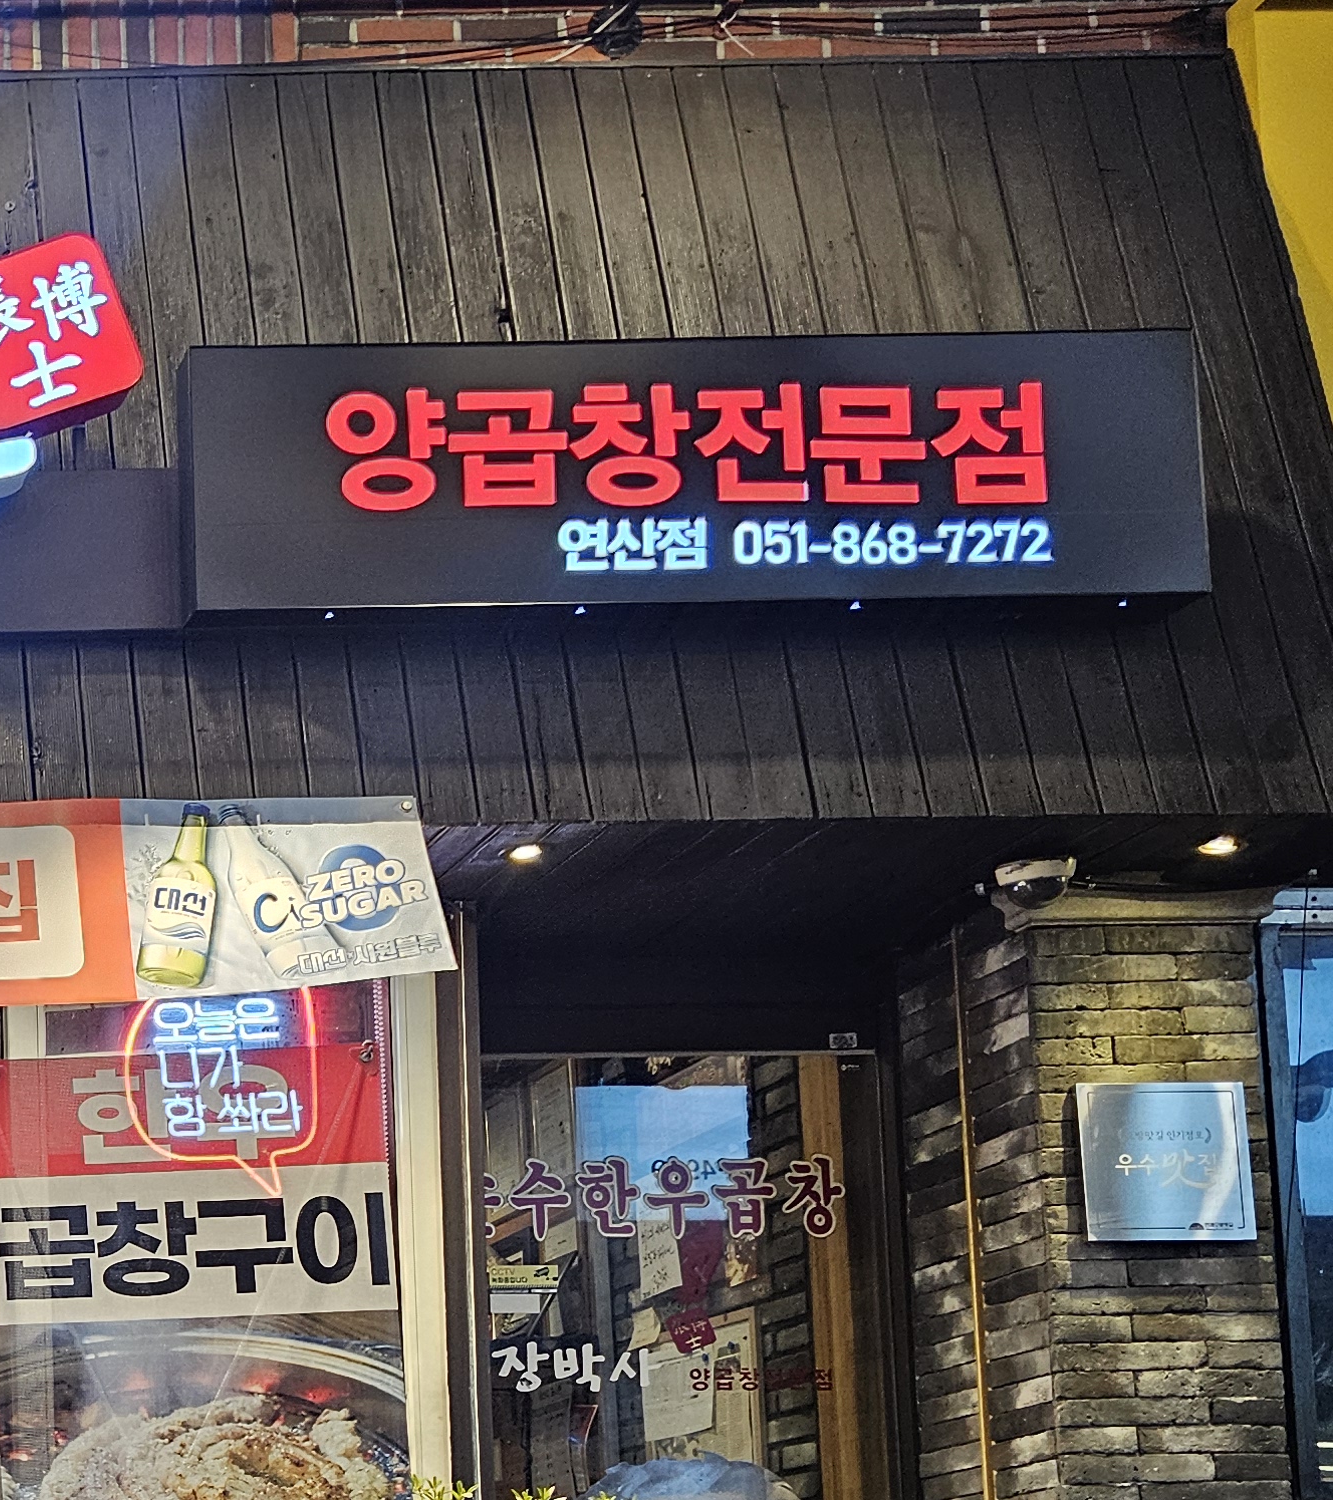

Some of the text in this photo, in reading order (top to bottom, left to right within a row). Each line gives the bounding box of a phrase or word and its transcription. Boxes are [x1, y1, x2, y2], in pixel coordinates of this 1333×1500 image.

[326, 382, 1050, 511] 양곱창전문점
[557, 516, 1053, 571] 연산점 051-868-7272
[153, 886, 208, 917] 대선
[306, 857, 406, 901] ZERO
[300, 877, 429, 929] SUGAR
[152, 996, 280, 1044] 오늘은
[158, 1046, 243, 1089] 니가
[689, 1366, 833, 1392] 양곱창점
